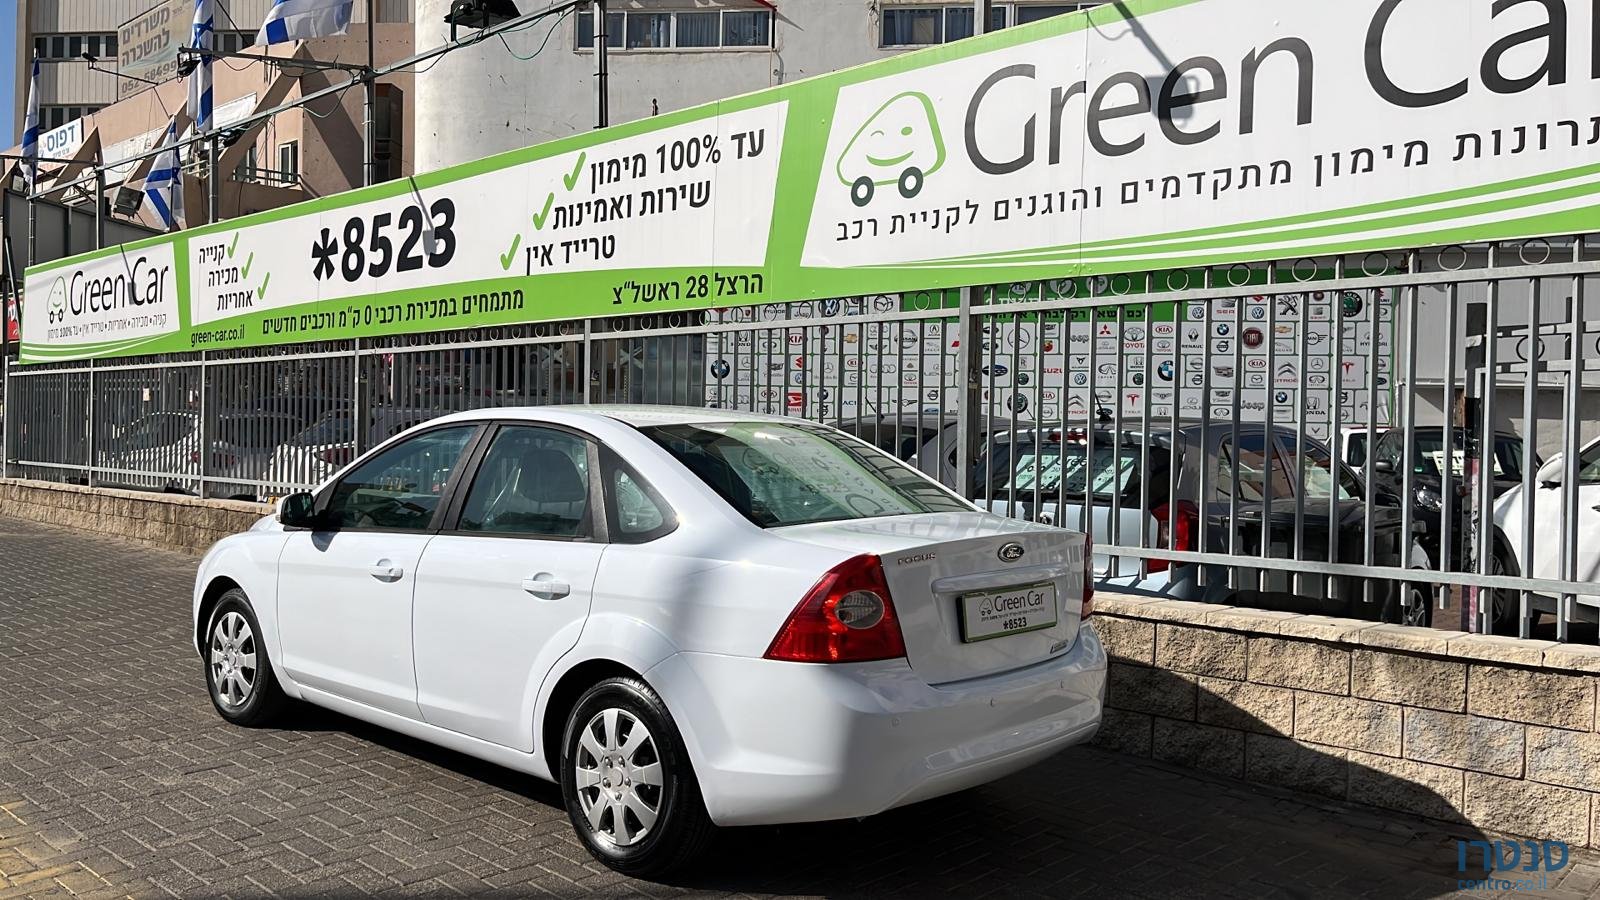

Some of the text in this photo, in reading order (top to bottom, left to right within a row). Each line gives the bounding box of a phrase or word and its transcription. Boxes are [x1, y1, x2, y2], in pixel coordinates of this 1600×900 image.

[122, 6, 170, 45] משרדים
[121, 28, 170, 67] להשכרה
[964, 0, 1600, 175] Green Ca
[47, 125, 75, 152] דפוס
[591, 128, 765, 194] עד 100% מימון
[1314, 139, 1428, 187] מימון
[1121, 159, 1291, 205] מתקדמים
[553, 180, 711, 230] שירות ואמינות
[889, 199, 979, 233] לקניית
[994, 186, 1102, 221] והוגנים
[836, 218, 878, 242] רכב
[198, 244, 225, 266] קנייה
[526, 234, 616, 276] טרייד אין
[70, 270, 126, 315] Green
[131, 256, 169, 306] Car
[208, 267, 239, 287] מכירה
[686, 275, 709, 299] 28
[714, 272, 764, 297] הרצל
[217, 289, 254, 311] אחריות
[405, 297, 457, 322] במכירת
[461, 289, 524, 315] מתמחים
[262, 315, 297, 335] חדשים
[300, 312, 335, 331] ורכבים
[375, 305, 401, 324] רכבי
[191, 324, 245, 348] green-car.co.il
[1070, 334, 1089, 343] eep
[1246, 333, 1259, 342] FIAT
[994, 590, 1044, 612] Green Car
